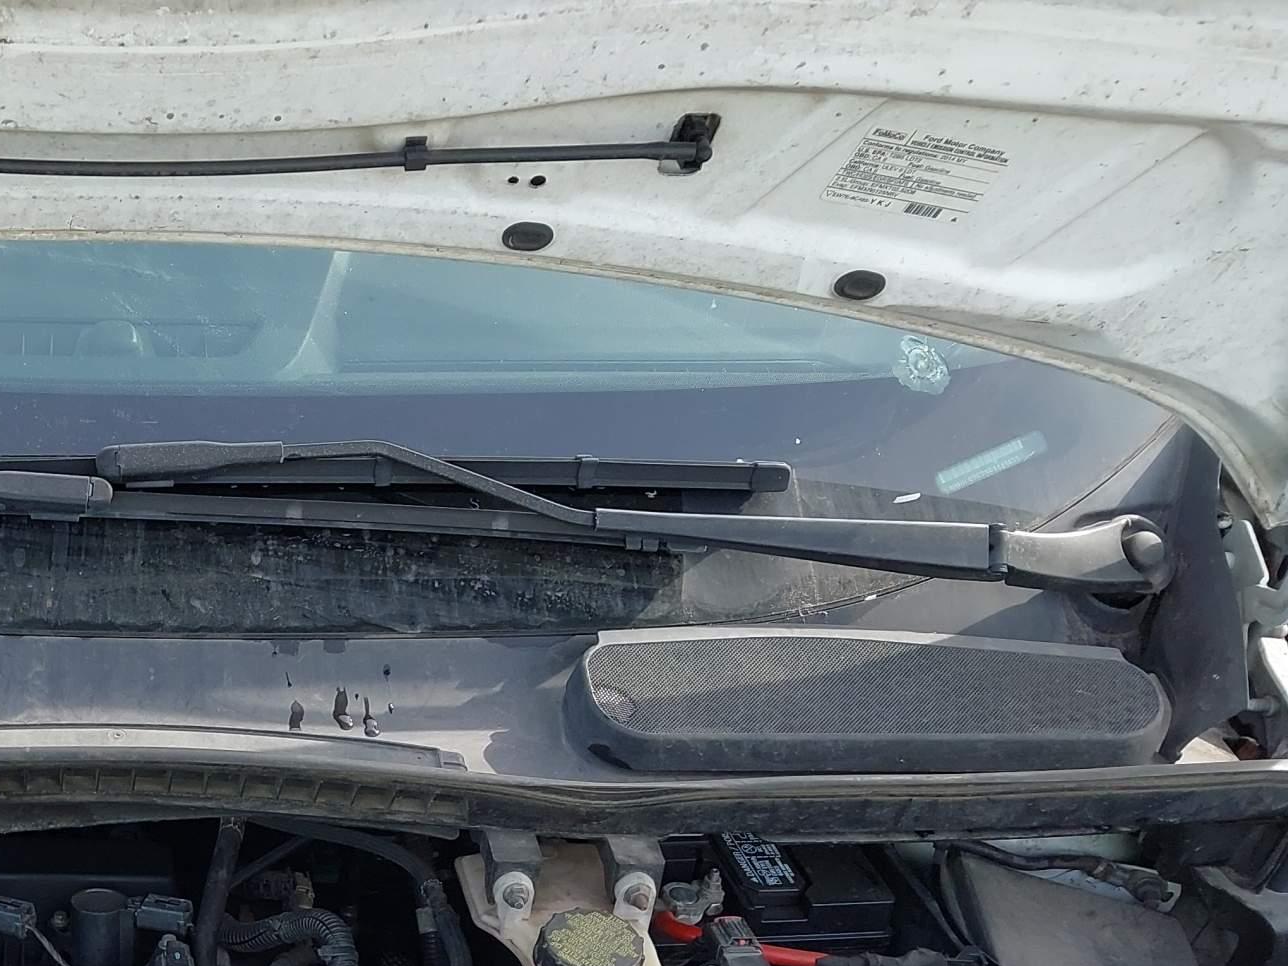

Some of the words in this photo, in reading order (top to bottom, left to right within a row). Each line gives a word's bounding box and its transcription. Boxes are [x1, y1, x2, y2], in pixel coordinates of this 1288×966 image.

[923, 134, 943, 144] Ford
[943, 138, 968, 148] Motor
[968, 143, 1006, 156] Company
